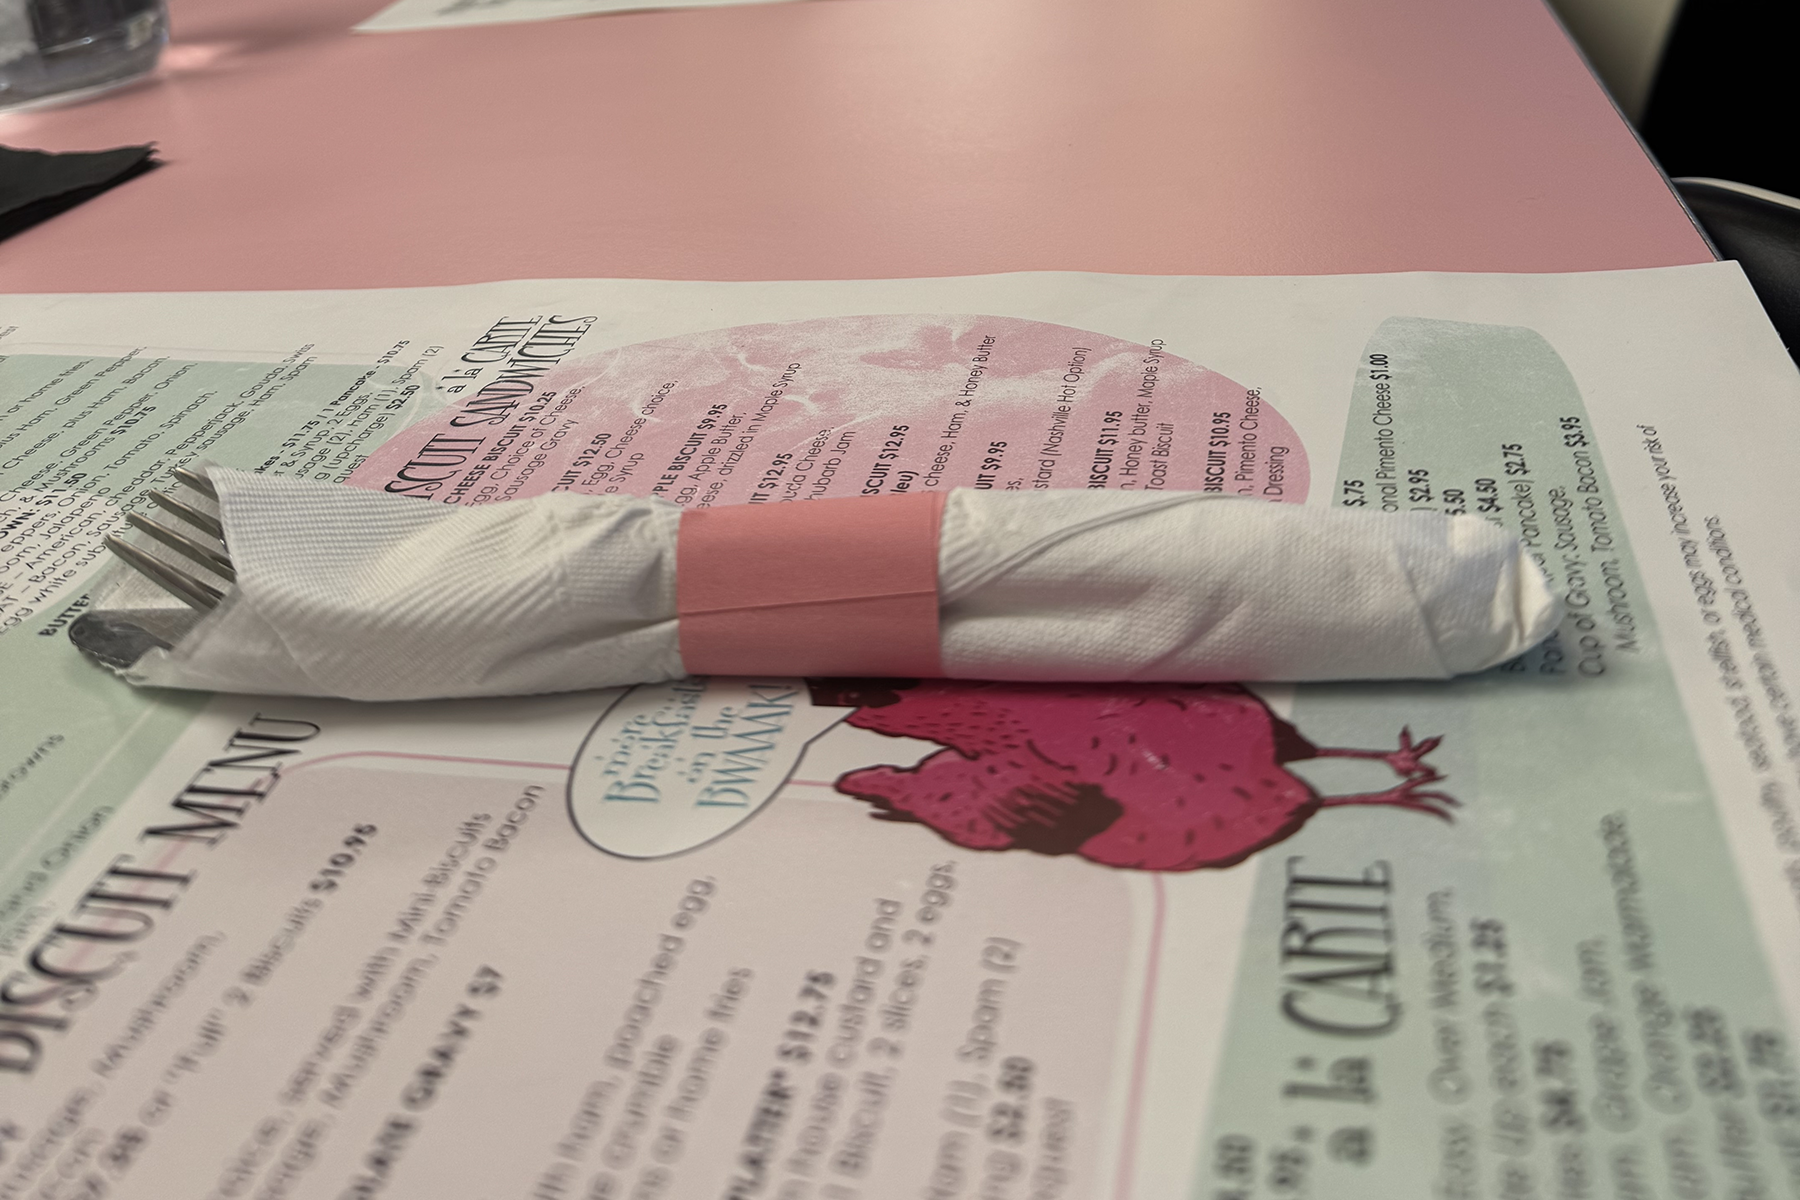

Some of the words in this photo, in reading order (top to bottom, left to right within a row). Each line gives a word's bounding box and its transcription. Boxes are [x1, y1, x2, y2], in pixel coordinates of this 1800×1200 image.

[283, 342, 315, 364] Swiss
[461, 315, 544, 364] CARTE
[972, 334, 997, 363] Butter
[1143, 338, 1168, 365] Syrup
[280, 355, 318, 381] Spam
[772, 362, 802, 389] Syrup
[957, 363, 989, 398] Honey
[1064, 346, 1092, 383] Option)
[1137, 366, 1160, 398] Maple
[1368, 353, 1389, 381] $1.00
[19, 378, 64, 403] home
[55, 378, 100, 406] Green
[281, 420, 320, 449] $11.75
[329, 370, 377, 406] Pancake
[376, 339, 410, 365] $10.75
[348, 403, 380, 428] Ham
[391, 358, 429, 386] Spam
[421, 345, 445, 357] (2)
[954, 397, 971, 408] &
[1056, 385, 1078, 403] Hot
[1372, 382, 1394, 427] Cheese
[62, 410, 93, 429] plus
[326, 417, 344, 426] 2
[384, 432, 487, 502] ISCUIT
[450, 314, 598, 428] SANDWICHES
[750, 388, 784, 422] Maple
[60, 428, 108, 458] Green
[322, 411, 397, 471] (upcharge)
[385, 383, 421, 411] $2.50
[604, 417, 648, 460] Cheese
[667, 432, 708, 472] BISCUIT
[696, 403, 728, 430] $9.95
[742, 423, 762, 434] in
[830, 431, 857, 455] Jam
[878, 424, 911, 460] $12.95
[1040, 404, 1072, 457] (Nashville
[1098, 410, 1124, 446] $11.95
[1151, 422, 1175, 458] Biscuit
[1208, 411, 1232, 448] $10.95
[1559, 416, 1591, 448] $3.95
[1636, 423, 1658, 437] of
[33, 436, 116, 493] Mushrooms
[110, 405, 157, 436] $10.75
[443, 463, 492, 506] CHEESE
[482, 424, 527, 462] BISCUIT
[518, 391, 557, 422] $10.25
[490, 439, 536, 481] Choice
[530, 427, 547, 439] of
[494, 453, 548, 502] Sausage
[540, 418, 580, 451] Gravy
[572, 432, 612, 468] $12.50
[687, 446, 723, 482] Apple
[716, 435, 755, 477] drizzled
[981, 441, 1008, 471] $9.95
[1118, 438, 1149, 477] Honey
[1234, 432, 1258, 482] Pimento
[1375, 428, 1398, 484] Pimento
[1501, 443, 1532, 476] $2.75
[1641, 437, 1664, 455] risk
[608, 452, 646, 483] Syrup
[757, 452, 794, 489] $12.95
[1144, 458, 1169, 491] Toast
[1262, 445, 1290, 496] Dressing
[1407, 468, 1435, 503] $2.95
[1572, 450, 1600, 494] Bacon
[1650, 455, 1678, 482] your
[35, 472, 88, 507] $11.50
[1342, 479, 1369, 508] $.75
[1474, 477, 1504, 513] $4.50
[1581, 496, 1616, 553] Tomato
[1660, 482, 1692, 536] increase
[1678, 536, 1703, 570] may
[28, 569, 77, 604] white
[1577, 635, 1608, 678] Cup
[138, 711, 322, 851] MENU
[307, 821, 379, 897] $10.95
[418, 856, 498, 947] Tomato
[481, 784, 546, 854] Bacon
[864, 896, 904, 955] and
[900, 926, 939, 949] 2
[1278, 853, 1405, 1040] CARTE
[602, 931, 688, 1070] poached
[703, 965, 756, 1024] fries
